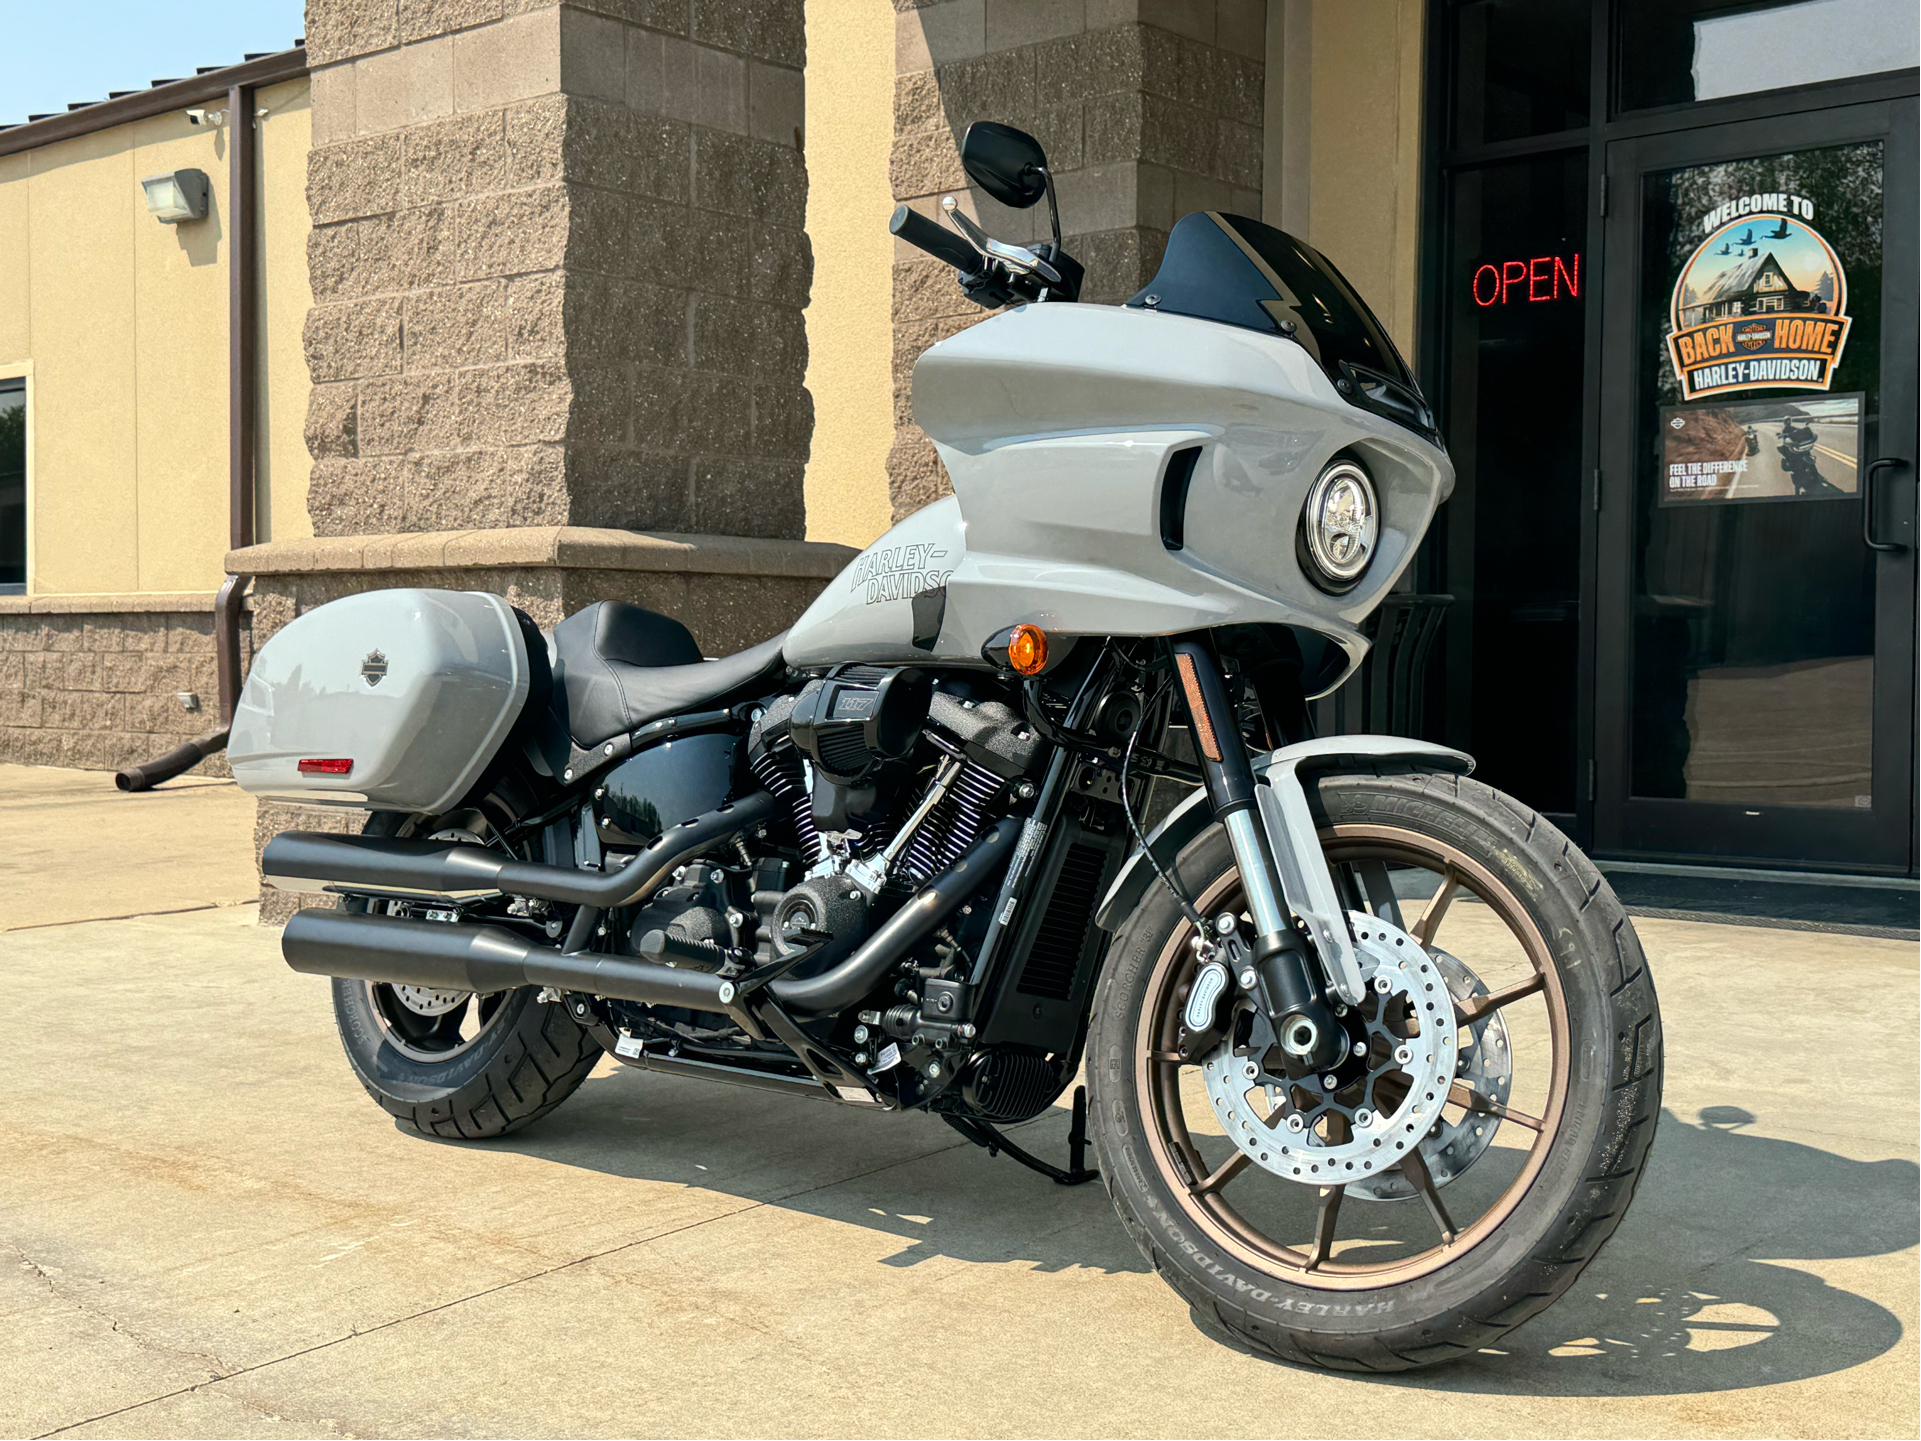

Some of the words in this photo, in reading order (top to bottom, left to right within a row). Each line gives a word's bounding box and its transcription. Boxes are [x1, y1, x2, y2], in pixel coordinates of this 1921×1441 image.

[1703, 193, 1788, 235] WELCOME
[1790, 195, 1815, 221] TO
[1473, 253, 1579, 307] OPEN
[1678, 323, 1736, 366] BACK
[1773, 319, 1839, 354] HOME
[1693, 359, 1820, 390] HARLEY-DAVIDSON
[1669, 463, 1687, 476] FEEL
[1687, 462, 1702, 475] THE
[1702, 460, 1748, 474] DIFFERENCE
[1669, 476, 1681, 488] ON
[1681, 475, 1696, 488] THE
[1696, 474, 1717, 487] ROAD
[851, 543, 948, 593] HARLEY-
